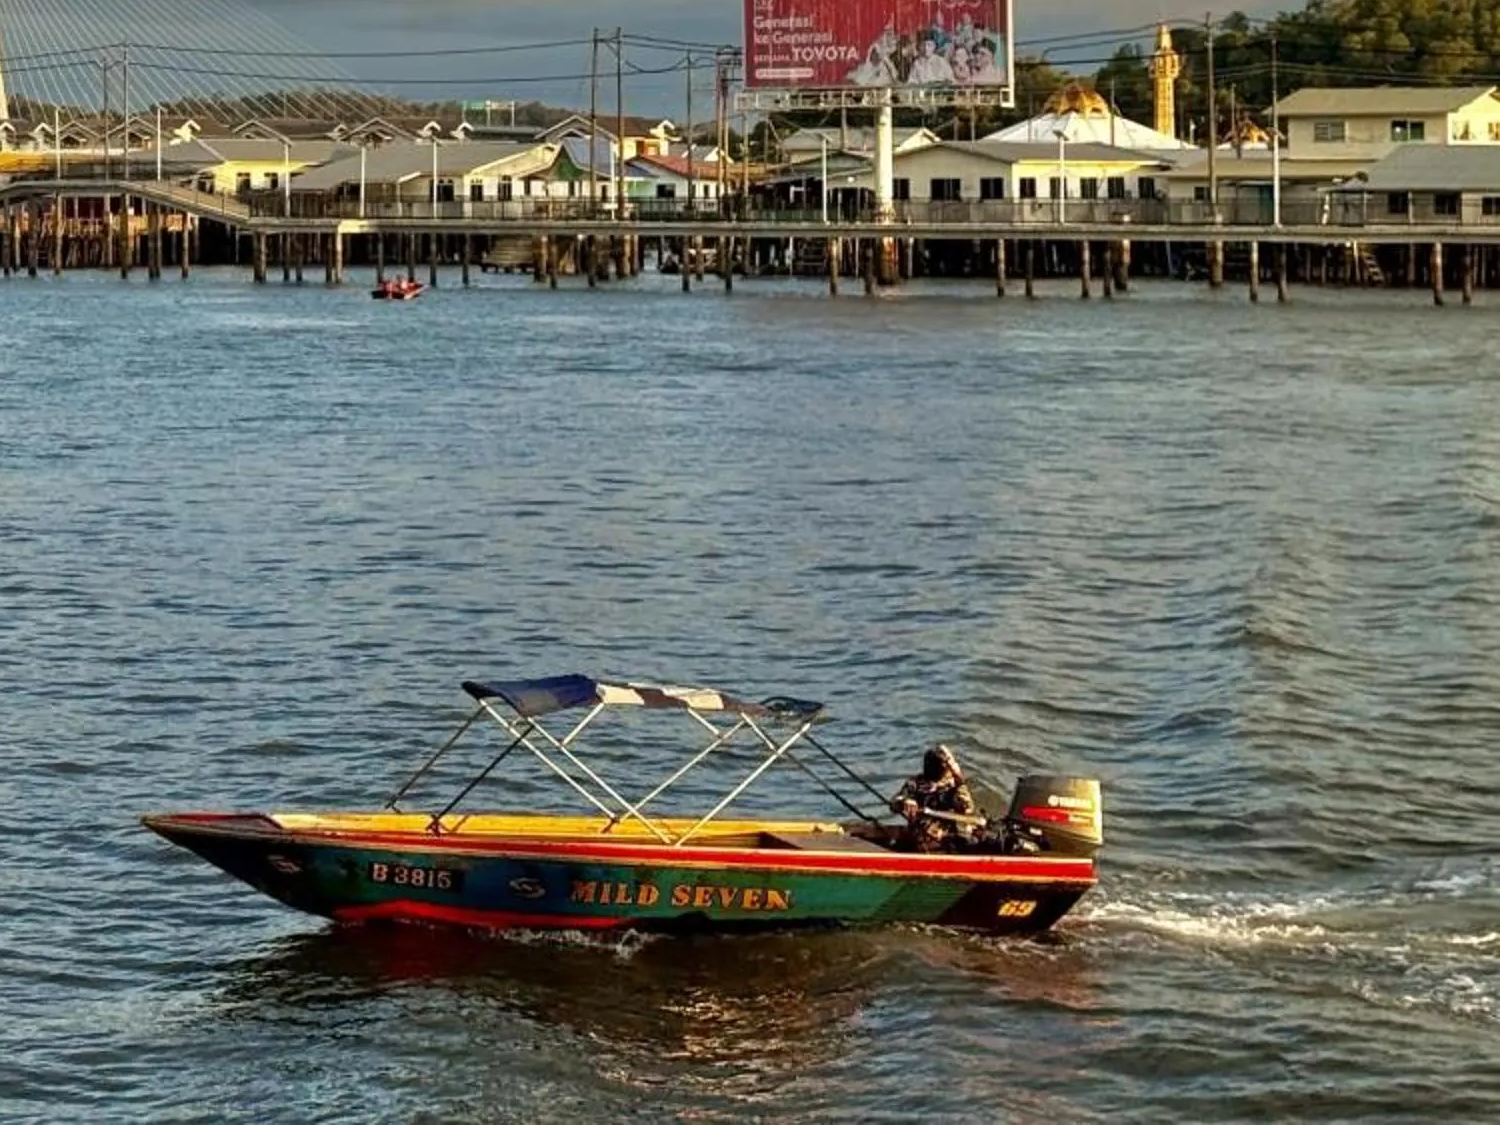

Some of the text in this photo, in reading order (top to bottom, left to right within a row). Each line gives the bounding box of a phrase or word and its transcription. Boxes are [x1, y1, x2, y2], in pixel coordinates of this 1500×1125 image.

[754, 13, 813, 28] Generasi
[772, 30, 833, 44] Generasi
[792, 46, 859, 62] TOYOTA
[373, 862, 452, 889] B 3815
[572, 880, 791, 910] MILD SEVEN
